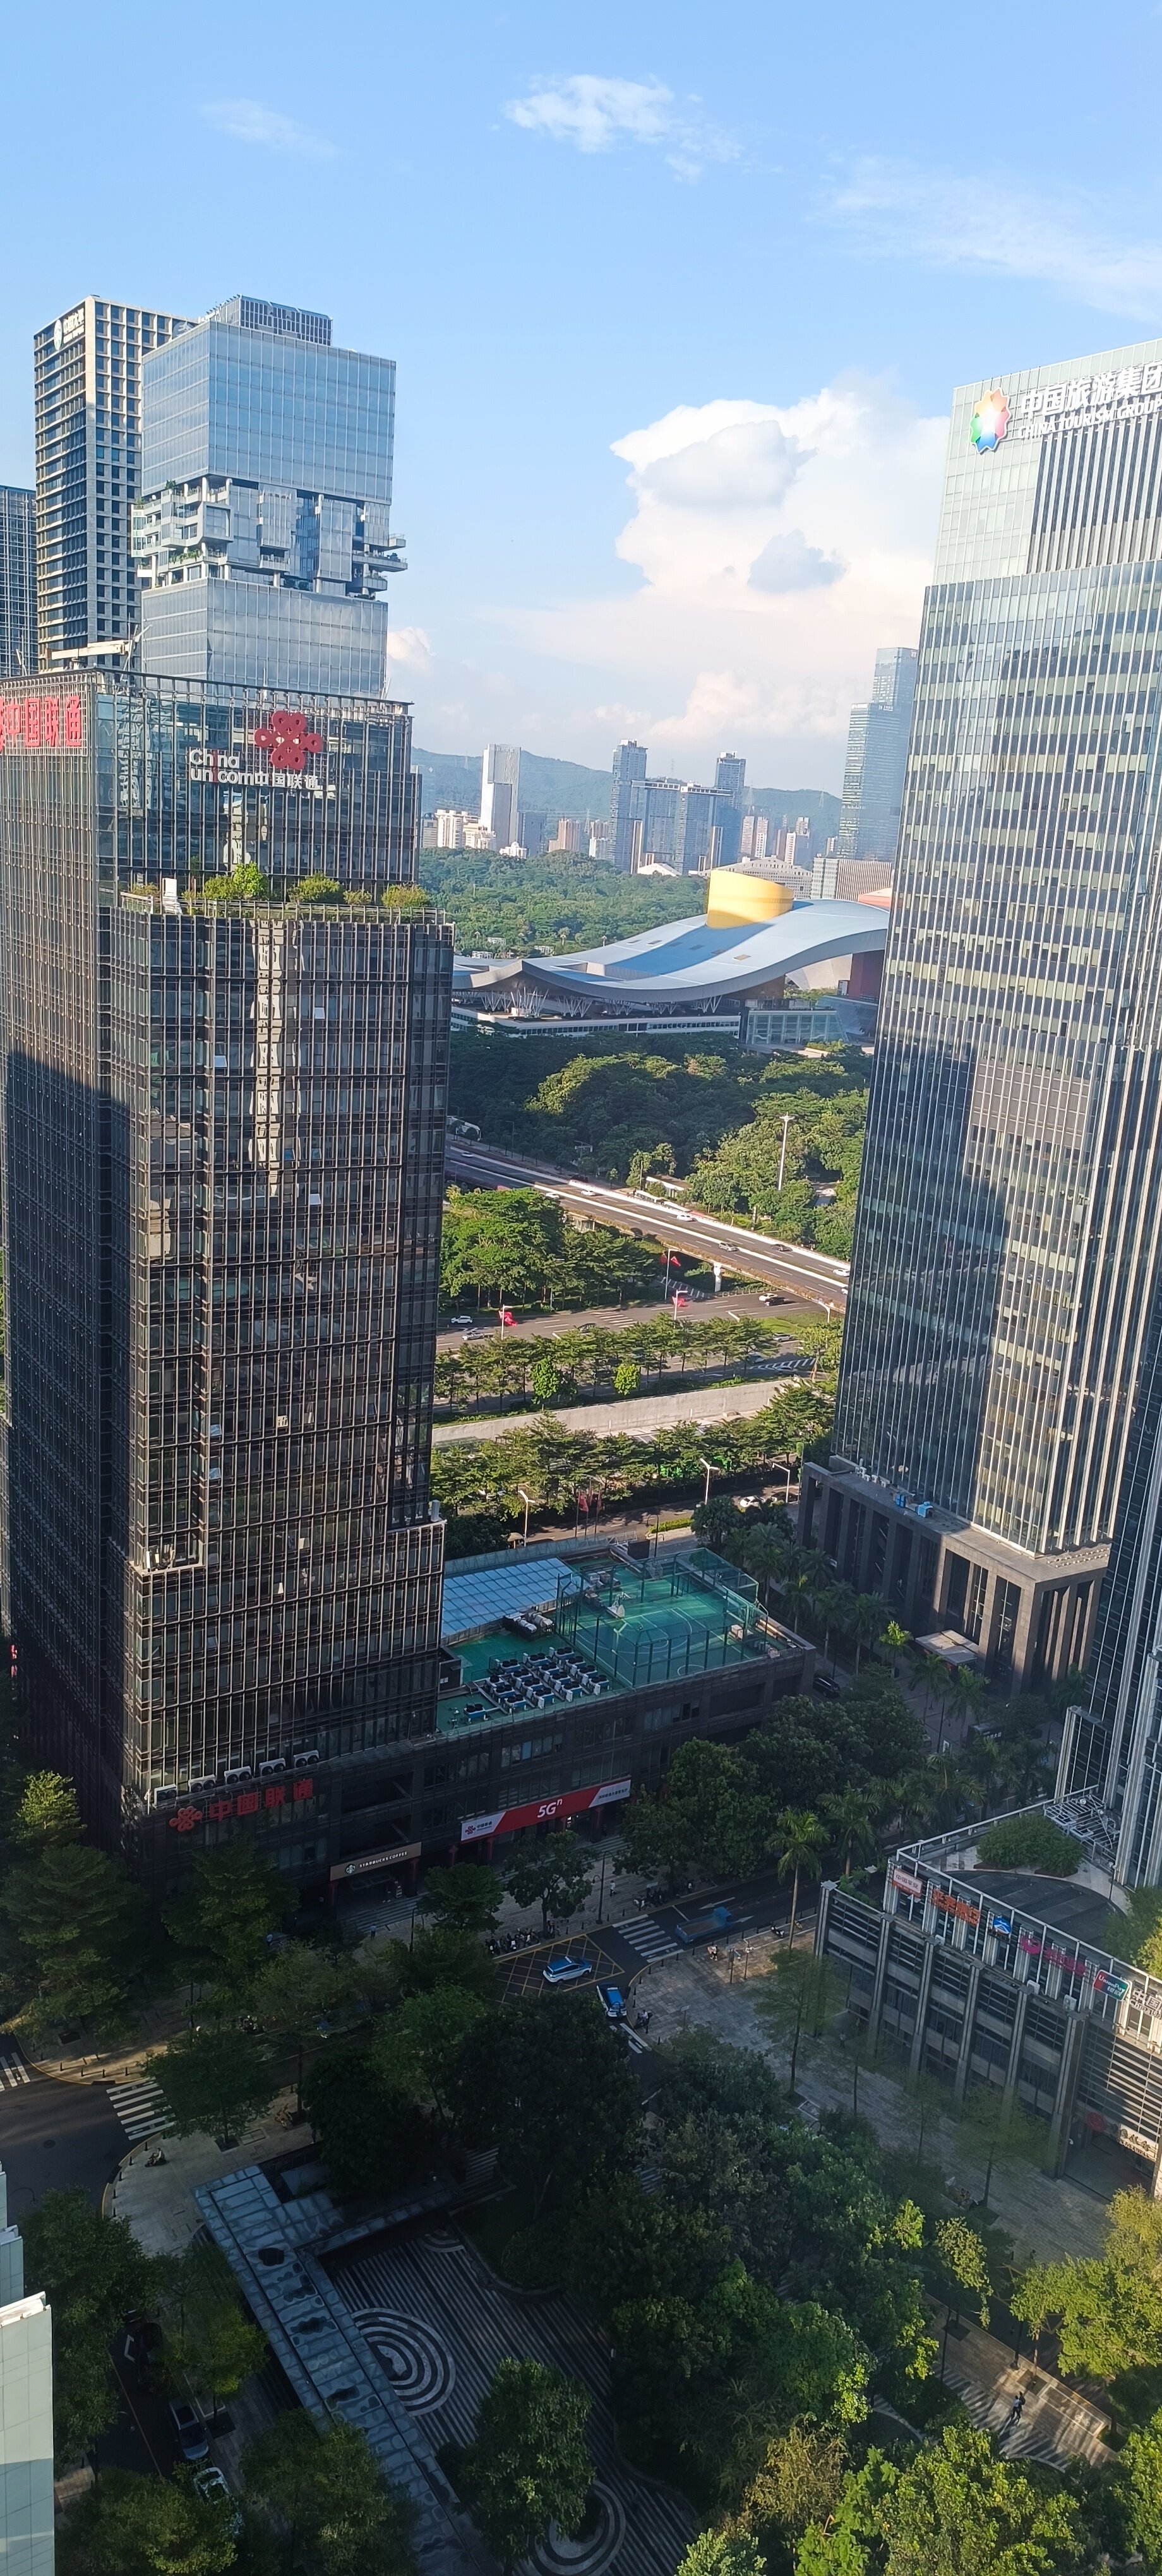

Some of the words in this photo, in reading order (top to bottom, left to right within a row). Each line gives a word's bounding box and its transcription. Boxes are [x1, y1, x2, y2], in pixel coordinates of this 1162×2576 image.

[1018, 420, 1057, 439] CHINA
[1058, 406, 1115, 431] TOURISM
[6, 696, 81, 748] 中国联通
[190, 749, 239, 768] China
[255, 771, 323, 790] 中国联通
[209, 1778, 313, 1822] 中国联通
[359, 1856, 388, 1868] STARBUCKS
[389, 1851, 407, 1859] COFFEE
[1098, 1974, 1125, 1996] UnionPay
